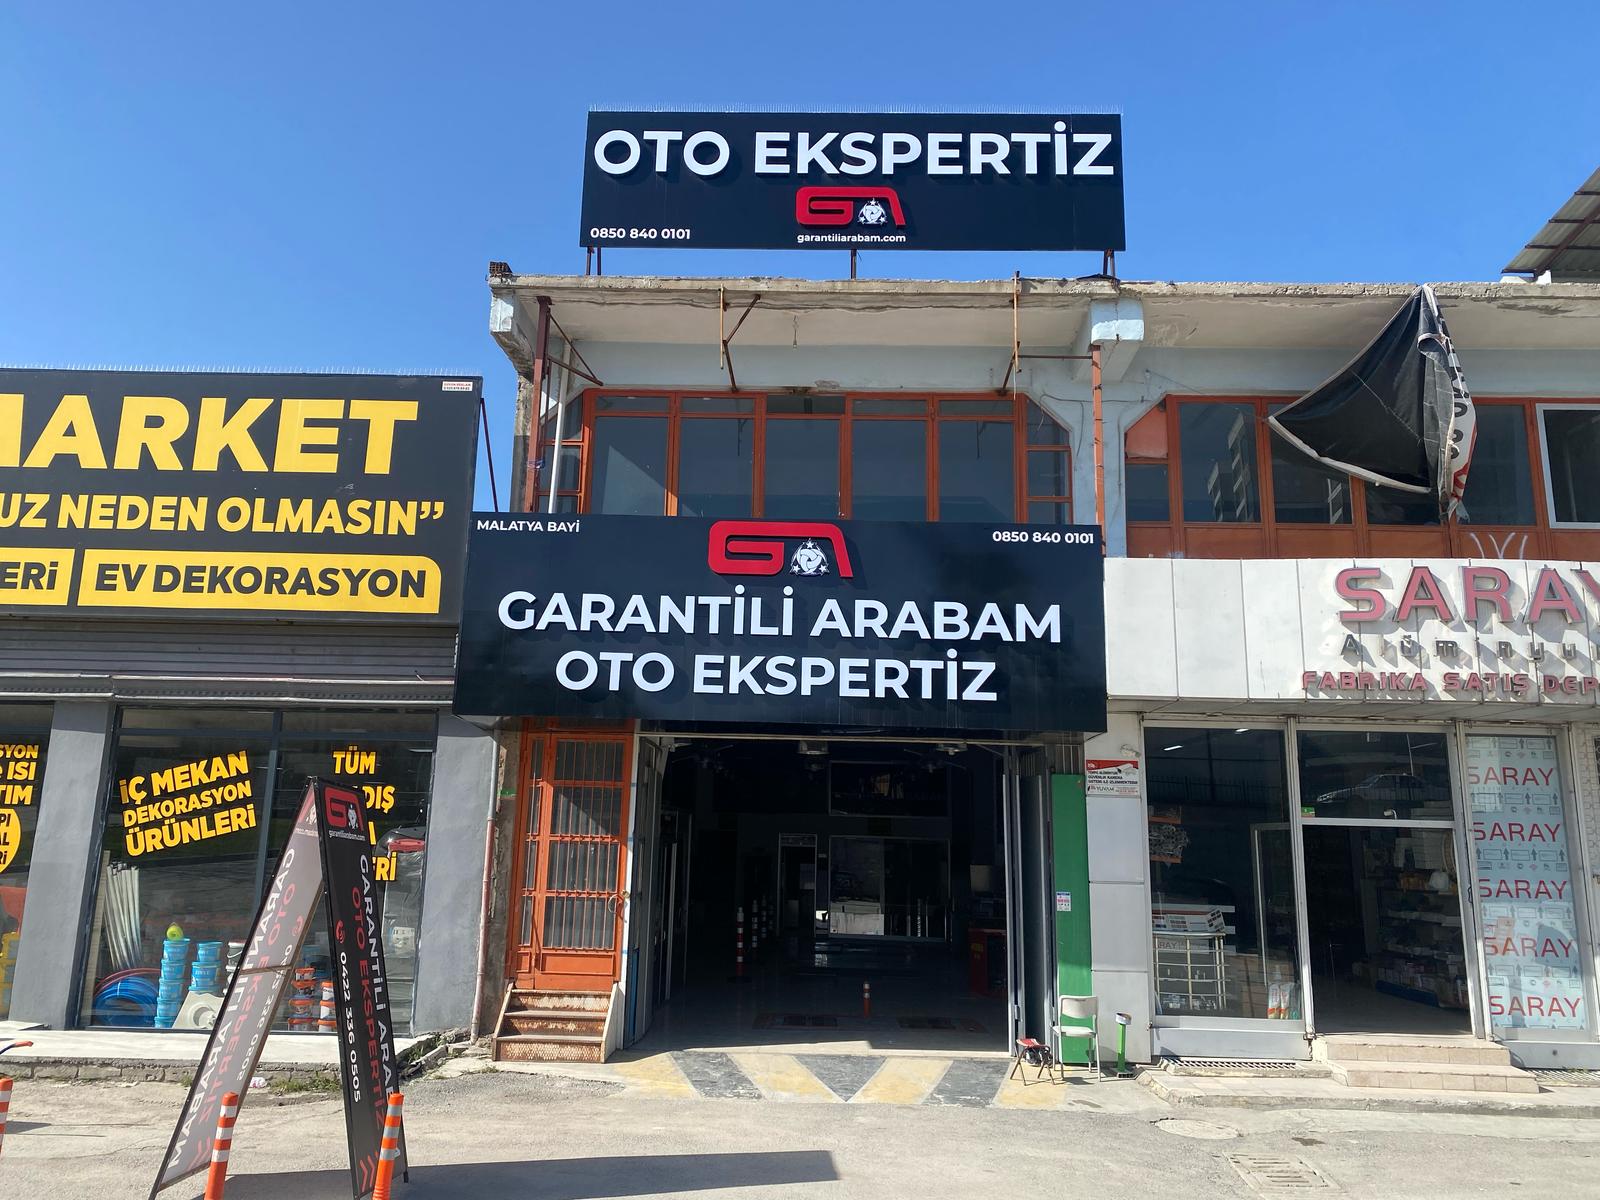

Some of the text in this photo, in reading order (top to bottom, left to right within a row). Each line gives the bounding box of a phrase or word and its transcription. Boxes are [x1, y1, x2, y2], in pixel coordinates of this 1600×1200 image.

[594, 121, 1114, 176] OTO EKSPERTİZ
[590, 226, 691, 240] 0850 840 0101
[796, 232, 907, 243] garantiliarabam.com
[57, 494, 208, 534] NEDEN
[476, 519, 580, 533] MALATYA BAYİ
[992, 530, 1094, 544] 0850 840 0101
[95, 563, 427, 598] EV DEKORASYON
[498, 584, 1061, 643] GARANTİLİ ARABAM
[555, 648, 998, 701] OTO EKSPERTİZ
[119, 750, 249, 805] İÇ MEKAN
[333, 746, 376, 775] TÜM
[1467, 766, 1554, 786] SARAY
[123, 780, 252, 828] DEKORASYON
[125, 803, 257, 857] ÜRÜNLERİ
[1473, 822, 1561, 843] SARAY
[1478, 878, 1568, 900] SARAY
[352, 887, 366, 950] OTO
[360, 854, 387, 1010] GARANTİLİ
[1484, 936, 1573, 958] SARAY
[1489, 995, 1581, 1018] SARAY
[340, 951, 361, 1103] 0422 336 0505
